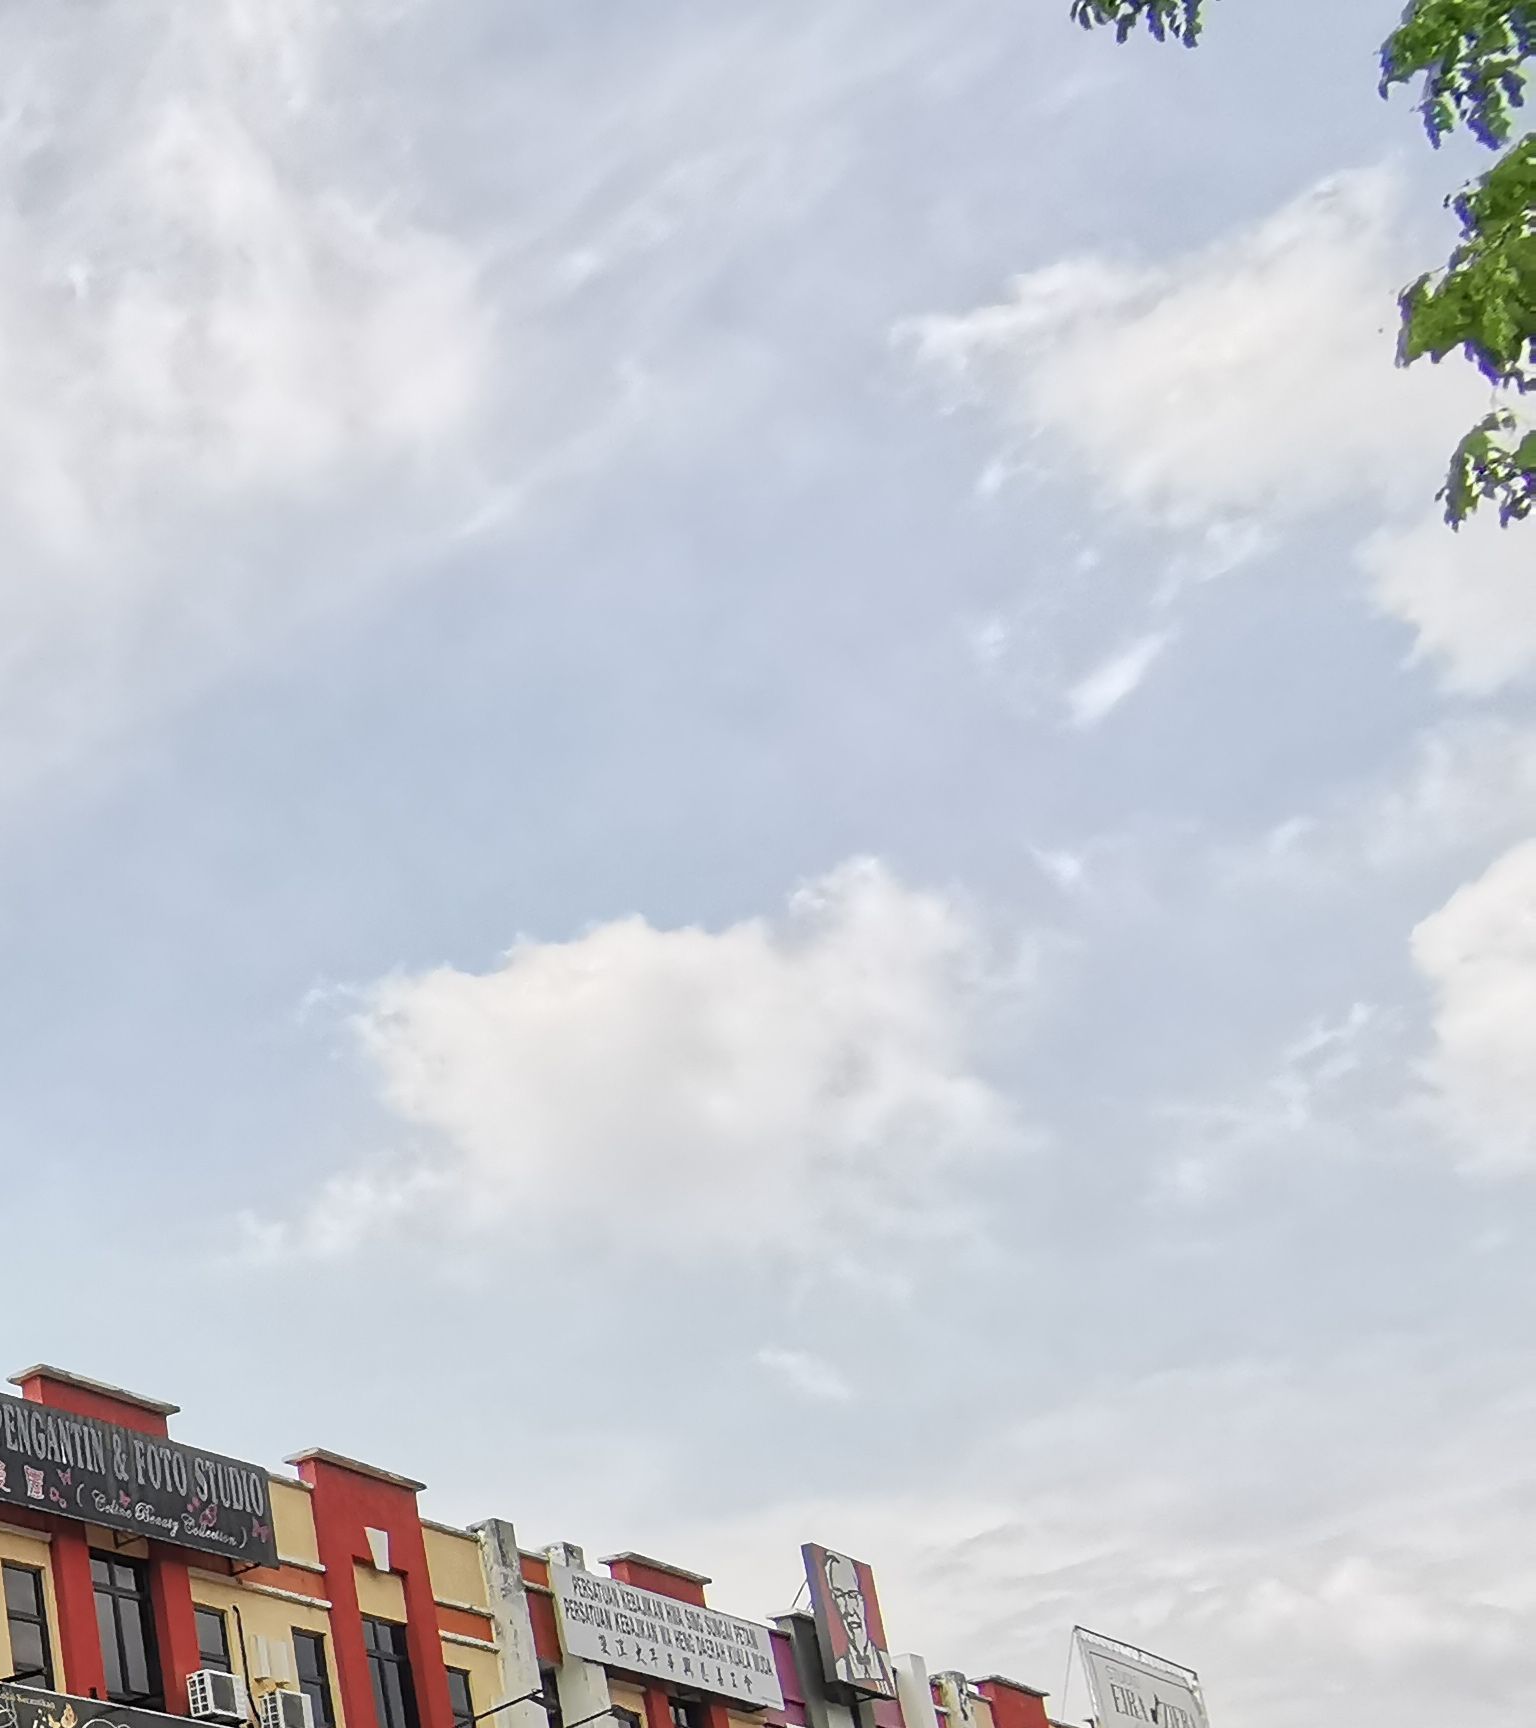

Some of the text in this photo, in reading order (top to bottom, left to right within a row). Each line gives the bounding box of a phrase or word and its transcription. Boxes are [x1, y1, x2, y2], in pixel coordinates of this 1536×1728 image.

[112, 1433, 129, 1481] &
[133, 1439, 187, 1496] FOTO
[194, 1457, 264, 1517] STUDIO
